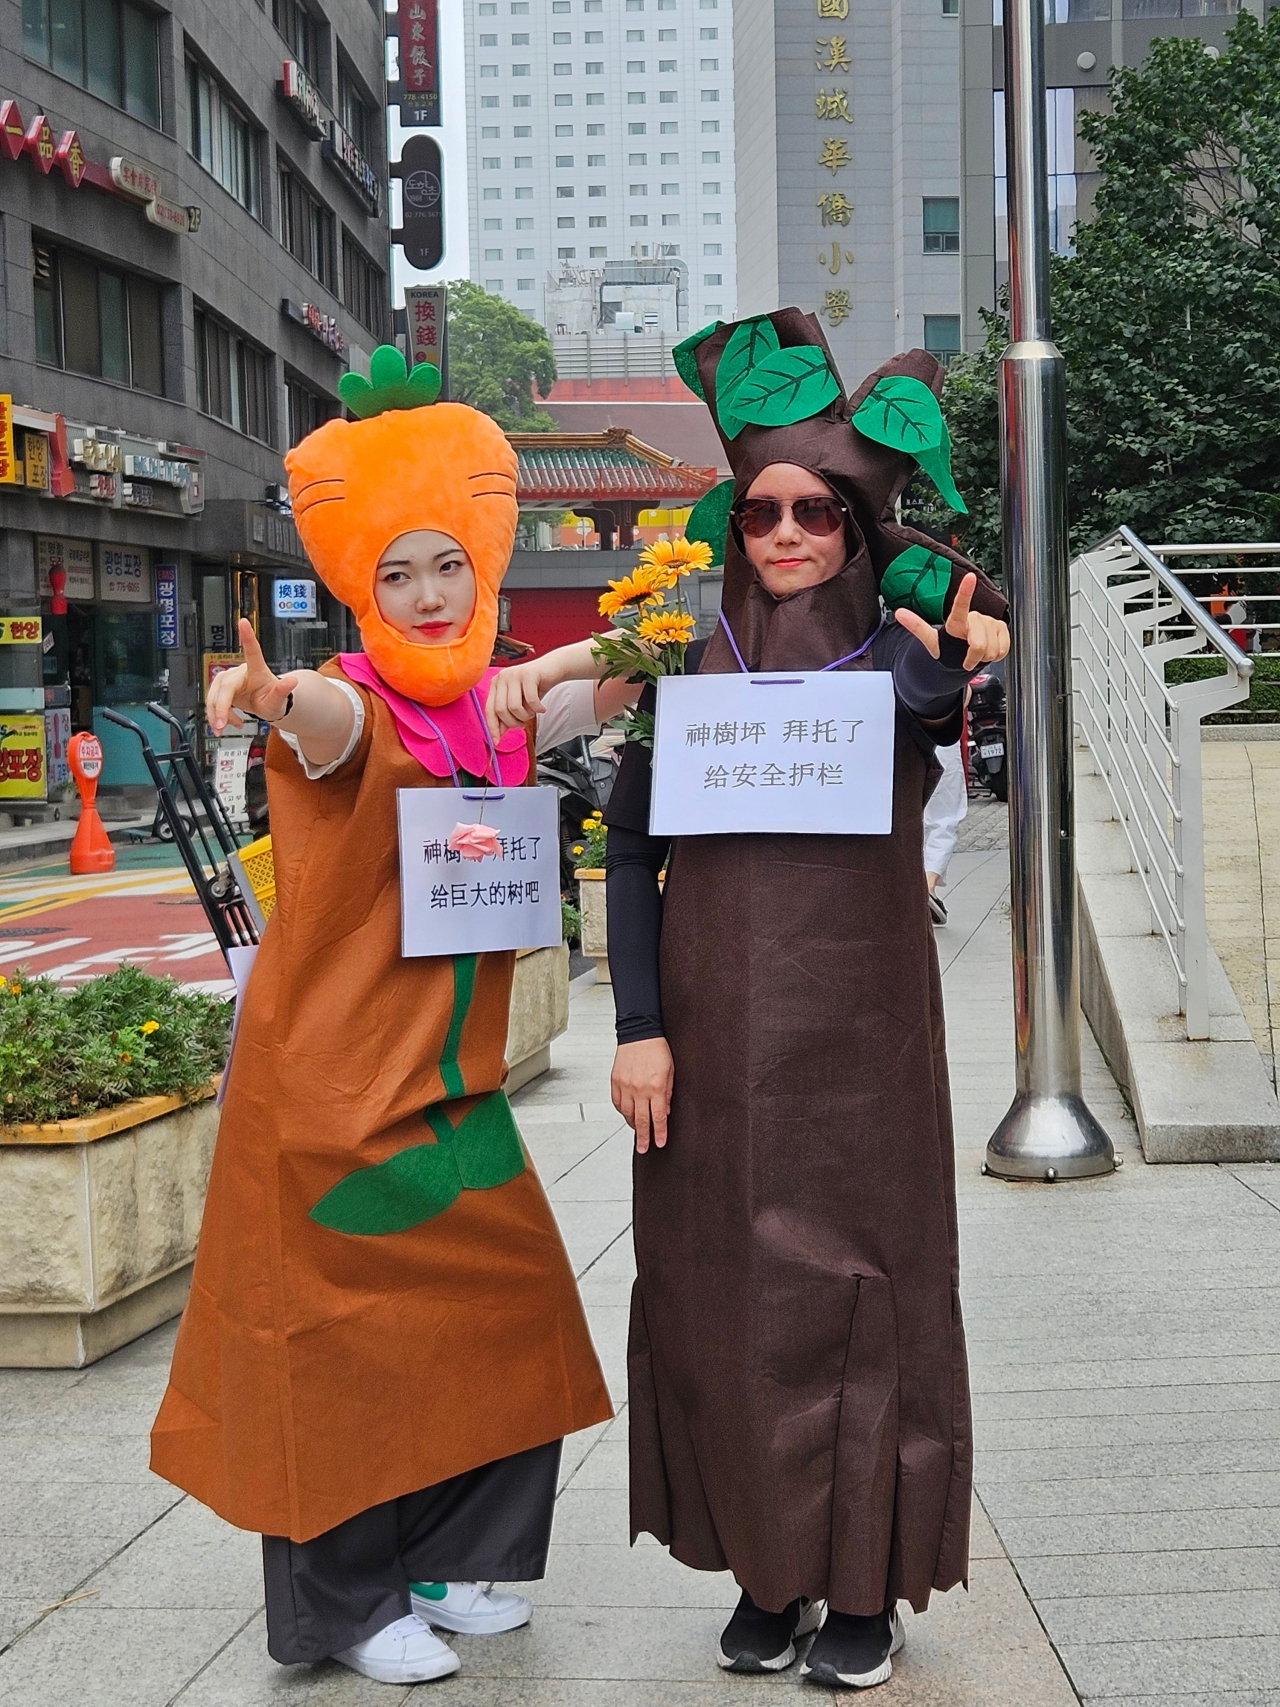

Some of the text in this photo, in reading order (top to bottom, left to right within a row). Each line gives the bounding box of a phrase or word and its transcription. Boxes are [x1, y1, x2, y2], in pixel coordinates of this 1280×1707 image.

[414, 110, 428, 121] 1F
[5, 125, 84, 179] 一品香
[415, 300, 437, 347] 換錢
[105, 550, 142, 578] 광명포장
[279, 584, 307, 598] 換錢
[10, 621, 40, 640] 한양
[685, 718, 865, 747] 神樹坪 拜托了
[703, 762, 844, 789] 给安全护栏
[430, 880, 540, 909] 给巨大的树吧
